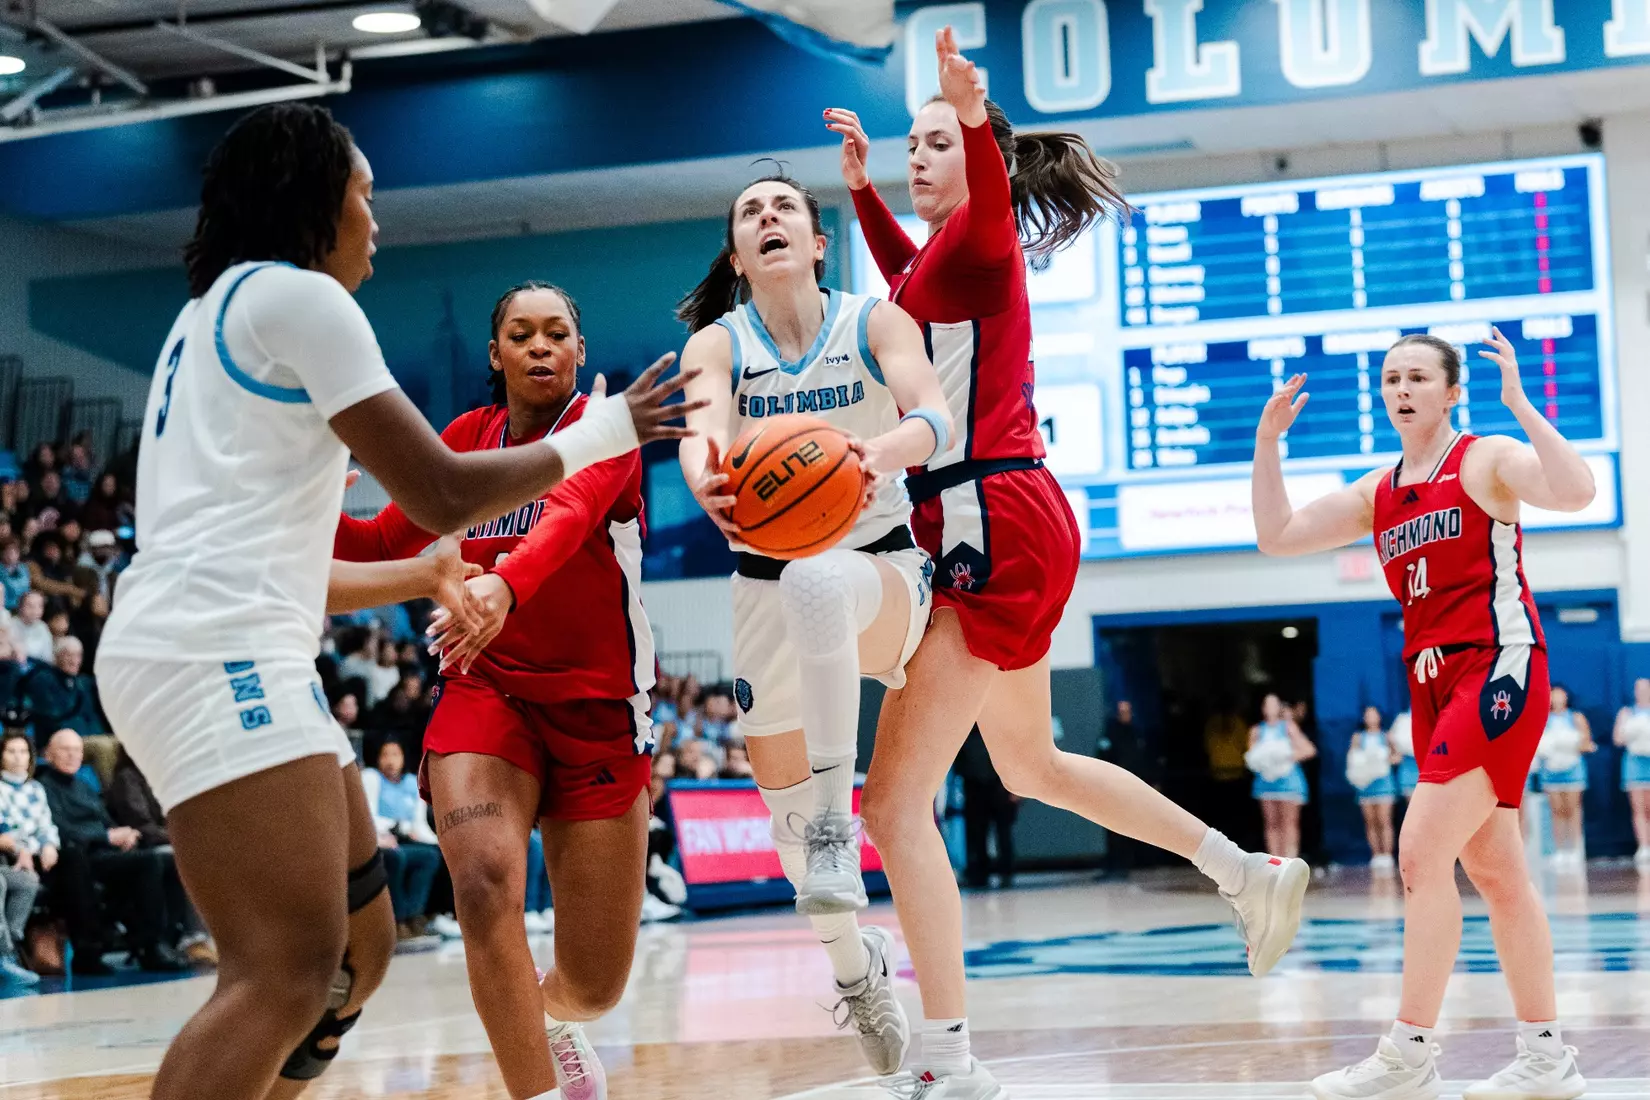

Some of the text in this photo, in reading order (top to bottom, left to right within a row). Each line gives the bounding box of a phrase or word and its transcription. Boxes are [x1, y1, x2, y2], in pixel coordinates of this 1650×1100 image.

[825, 355, 842, 366] Ivy
[738, 380, 865, 418] COLUMBIA
[752, 439, 825, 502] ELITE
[1379, 507, 1462, 566] RICHMOND
[1406, 556, 1432, 606] 14
